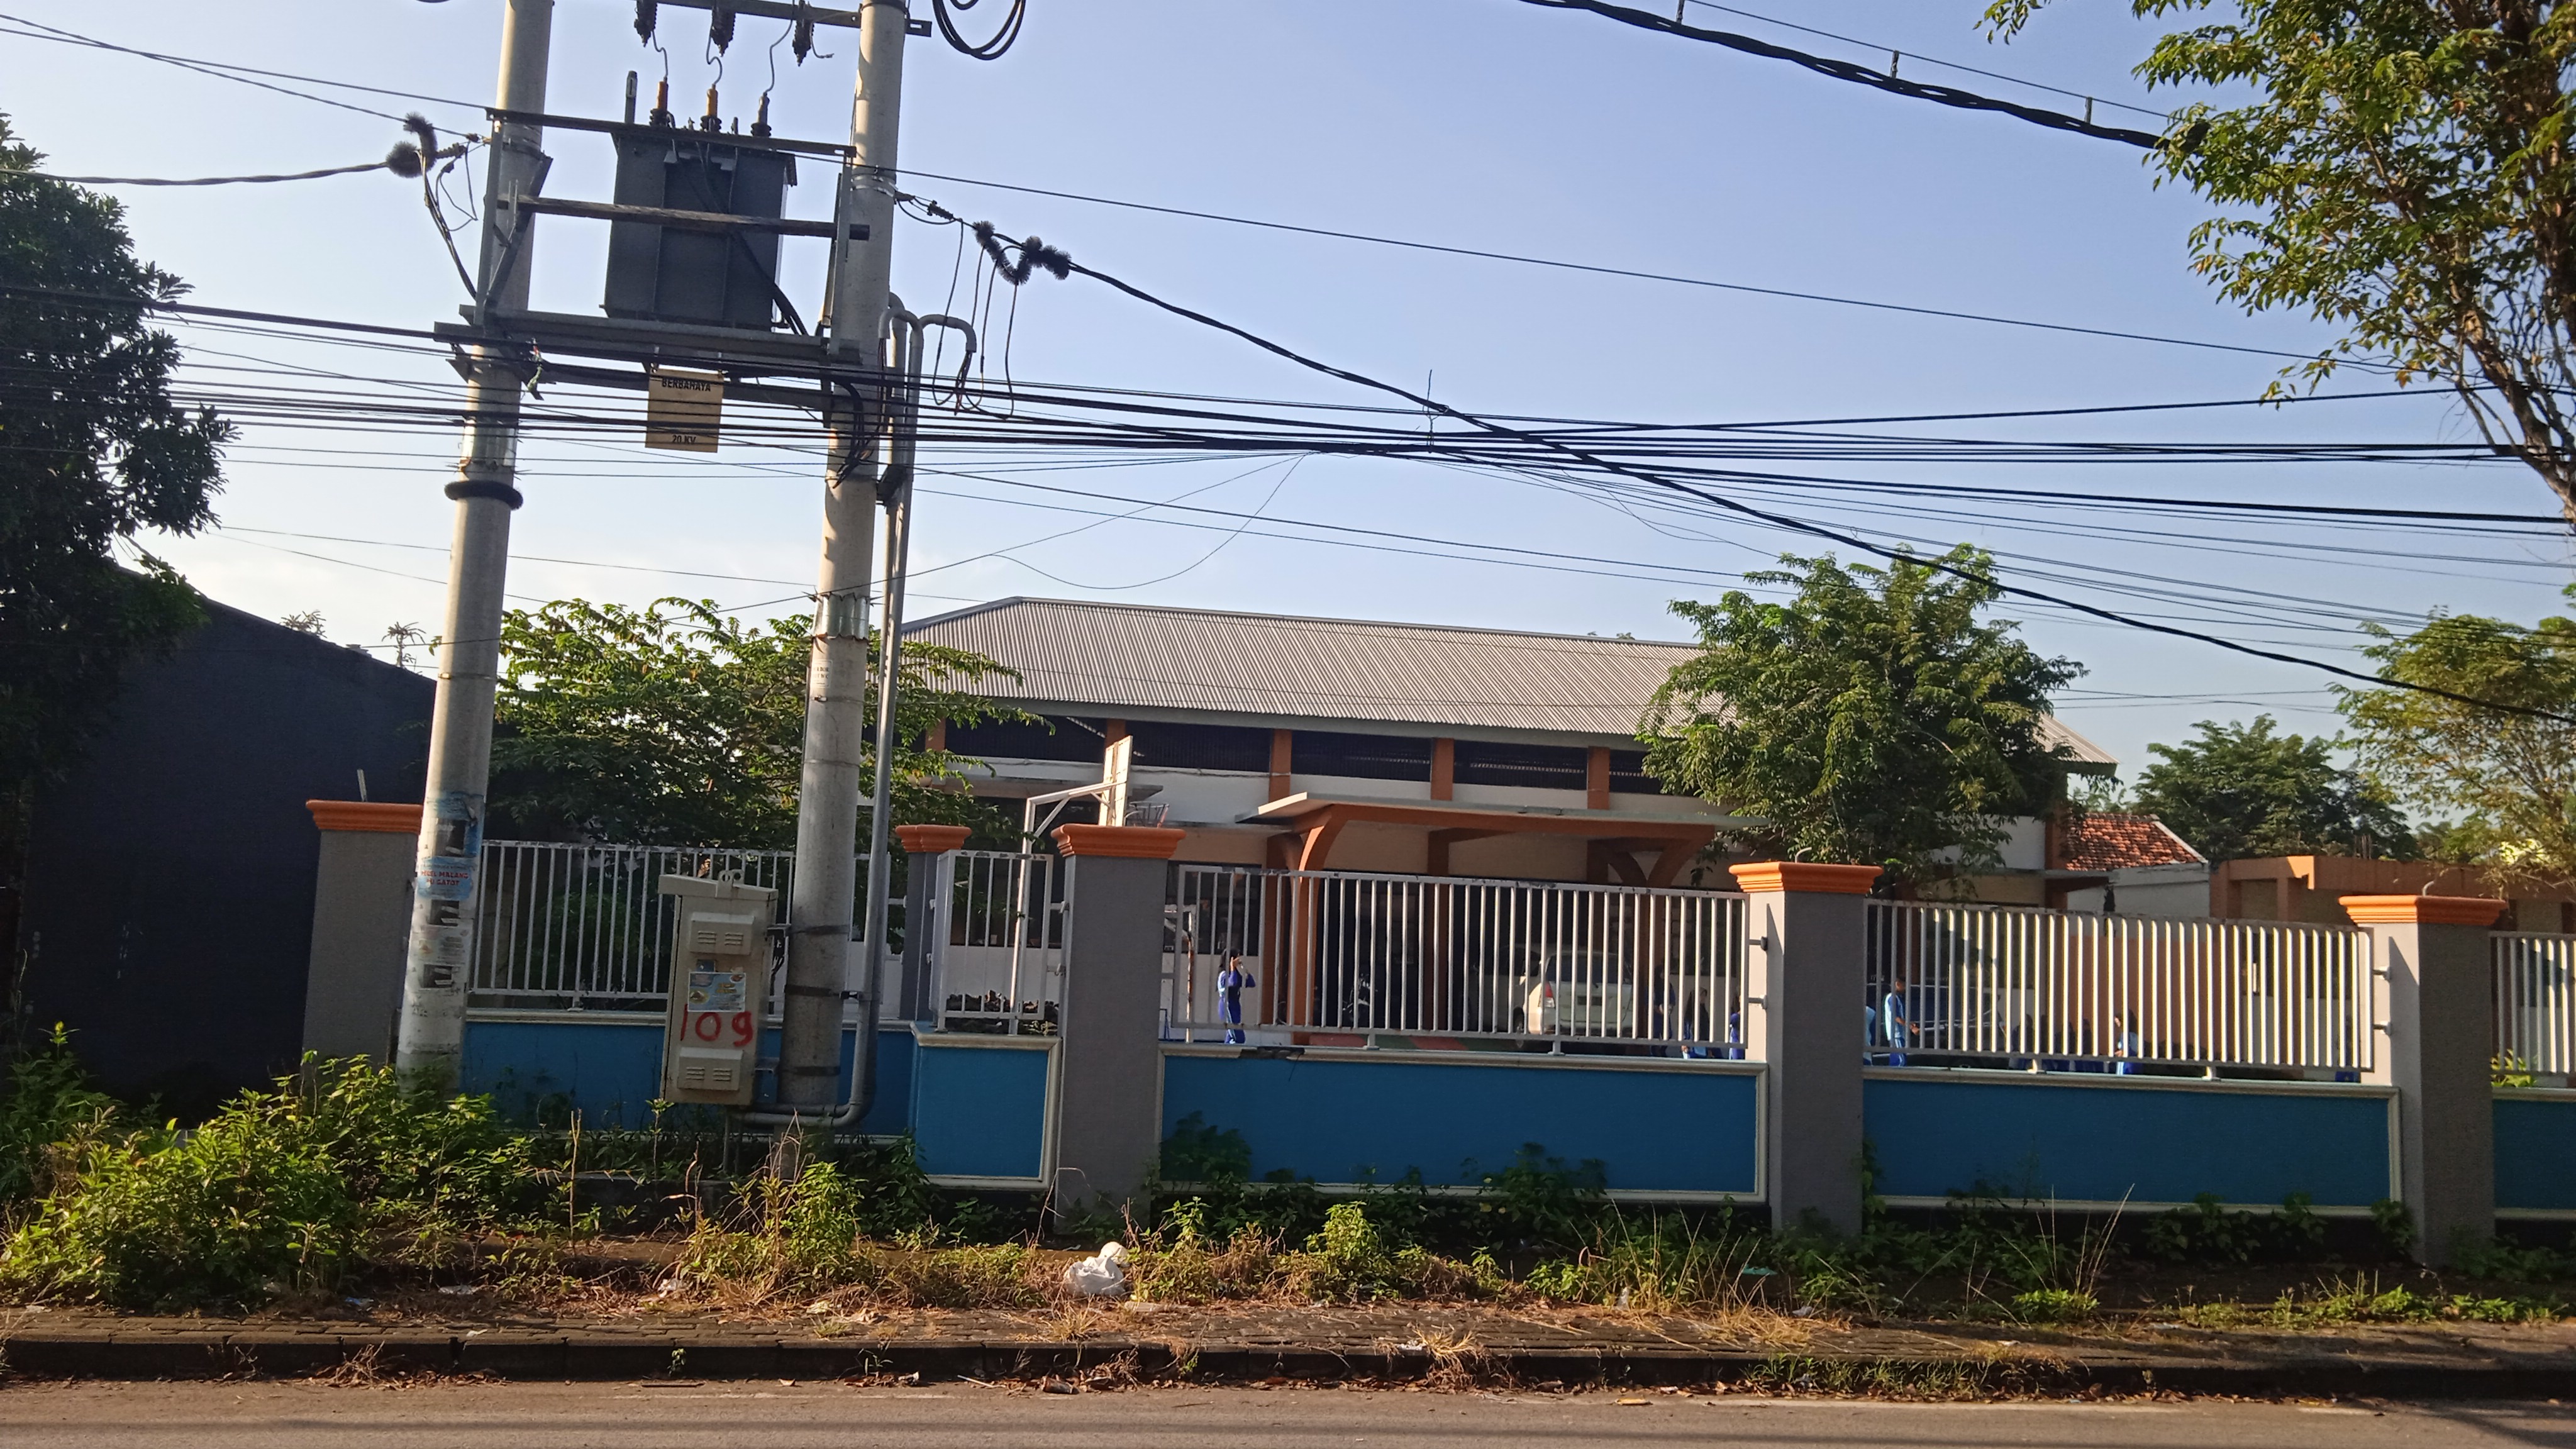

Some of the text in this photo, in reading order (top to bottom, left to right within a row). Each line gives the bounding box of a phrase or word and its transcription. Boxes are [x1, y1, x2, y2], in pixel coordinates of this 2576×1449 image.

[662, 377, 711, 391] BERBAHAYA
[672, 435, 696, 444] 20 KV
[680, 1002, 753, 1047] 109
